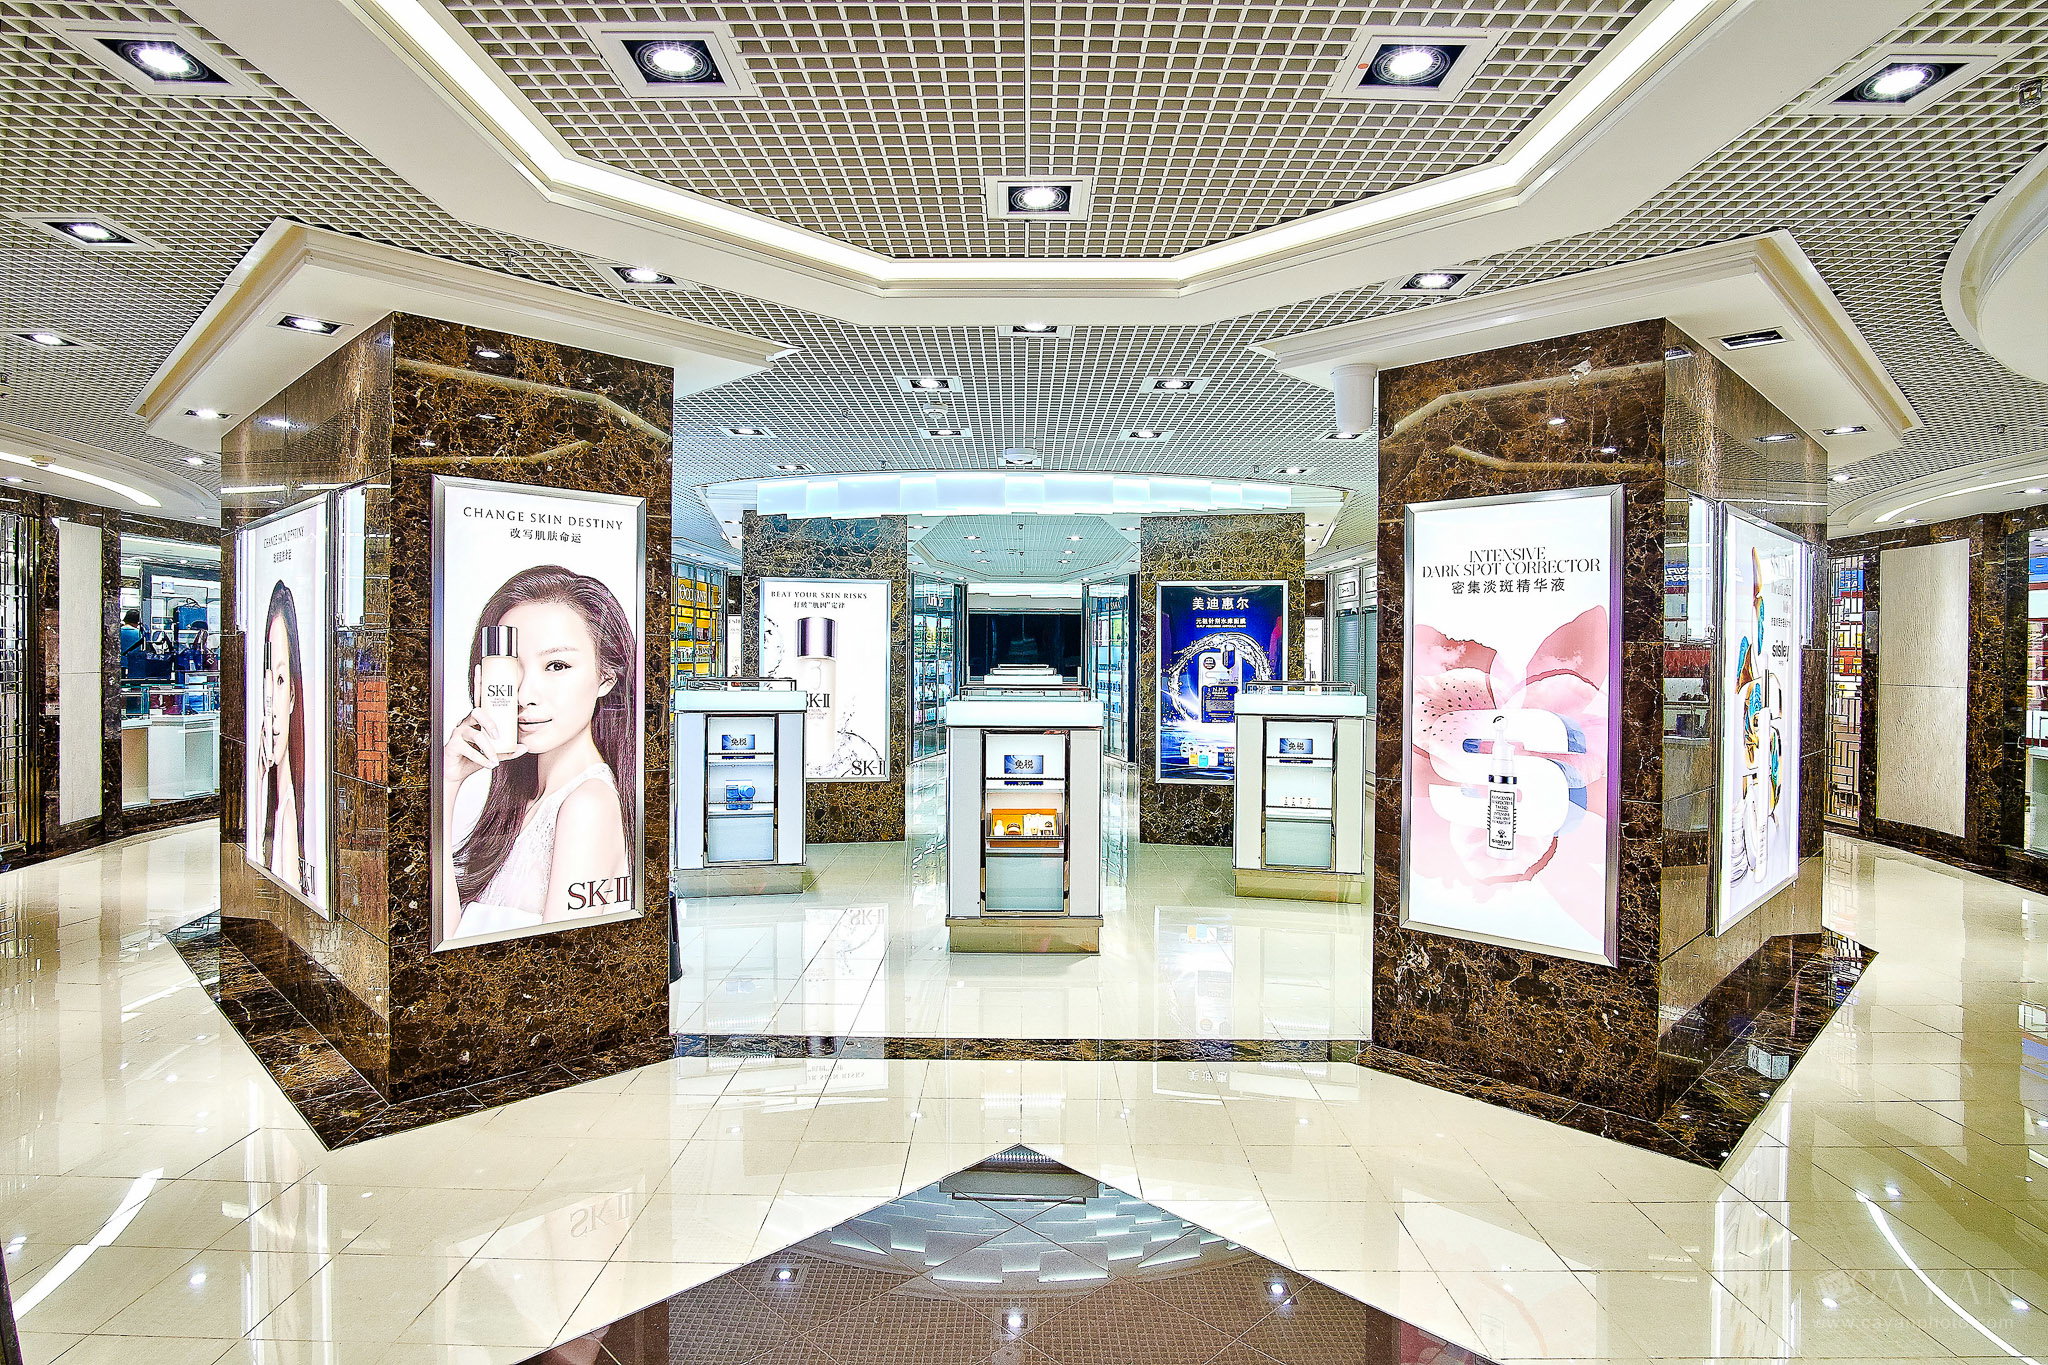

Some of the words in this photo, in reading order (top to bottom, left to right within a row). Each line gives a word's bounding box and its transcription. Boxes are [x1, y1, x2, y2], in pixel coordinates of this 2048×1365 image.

[463, 506, 525, 522] CHANGE
[530, 512, 563, 525] SKIN
[568, 516, 624, 531] DESTINY
[510, 527, 582, 544] 改写肌肤命运
[1469, 546, 1546, 563] INTENSIVE
[1422, 565, 1460, 578] DARK
[1463, 562, 1501, 577] SPOT
[1505, 558, 1601, 575] CORRECTOR
[1451, 577, 1566, 595] 密集淡斑精华液
[794, 591, 817, 599] YOUR
[1192, 596, 1249, 611] 美迪惠尔
[1771, 640, 1790, 662] sisley
[487, 684, 513, 697] SK-II
[731, 738, 747, 747] 免税
[1288, 742, 1305, 751] 免税
[1015, 759, 1034, 770] 免税
[567, 876, 631, 911] SK-II
